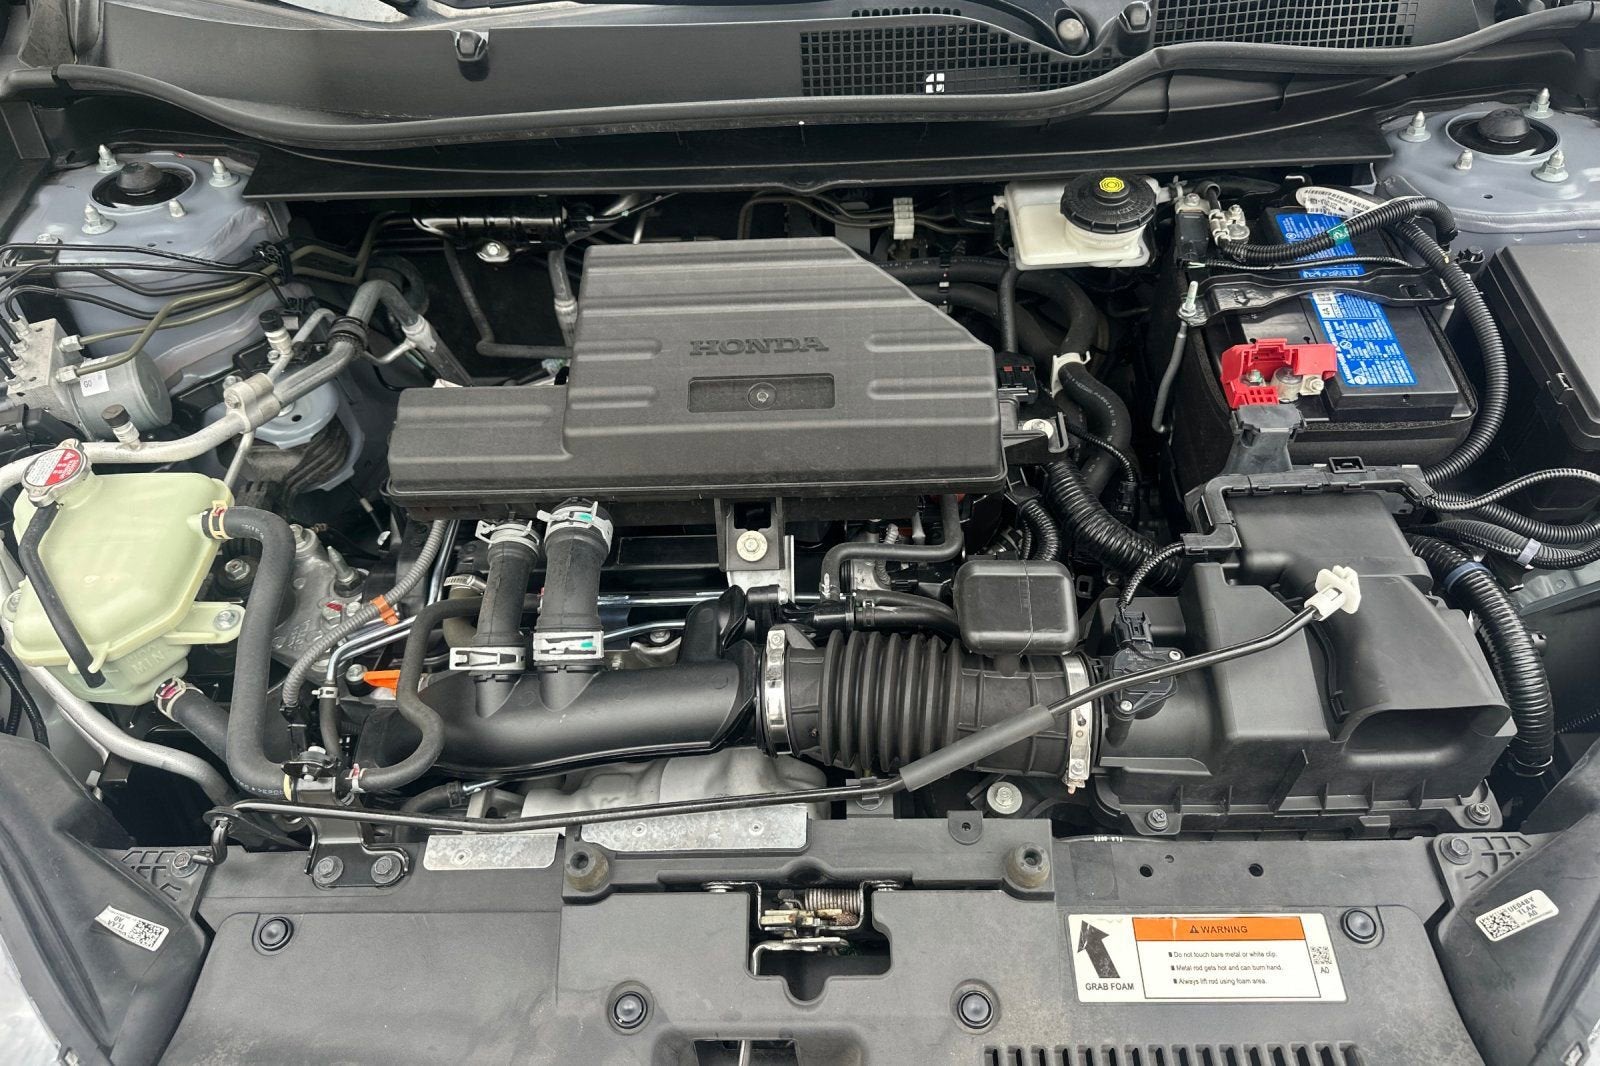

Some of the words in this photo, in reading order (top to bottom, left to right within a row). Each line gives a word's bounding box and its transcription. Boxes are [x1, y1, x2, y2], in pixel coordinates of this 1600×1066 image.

[689, 336, 830, 356] HONDA
[1200, 925, 1248, 934] WARNING
[1085, 982, 1109, 991] GRAB
[1110, 982, 1135, 991] FOAM
[1178, 978, 1199, 986] Always
[1219, 978, 1235, 986] using
